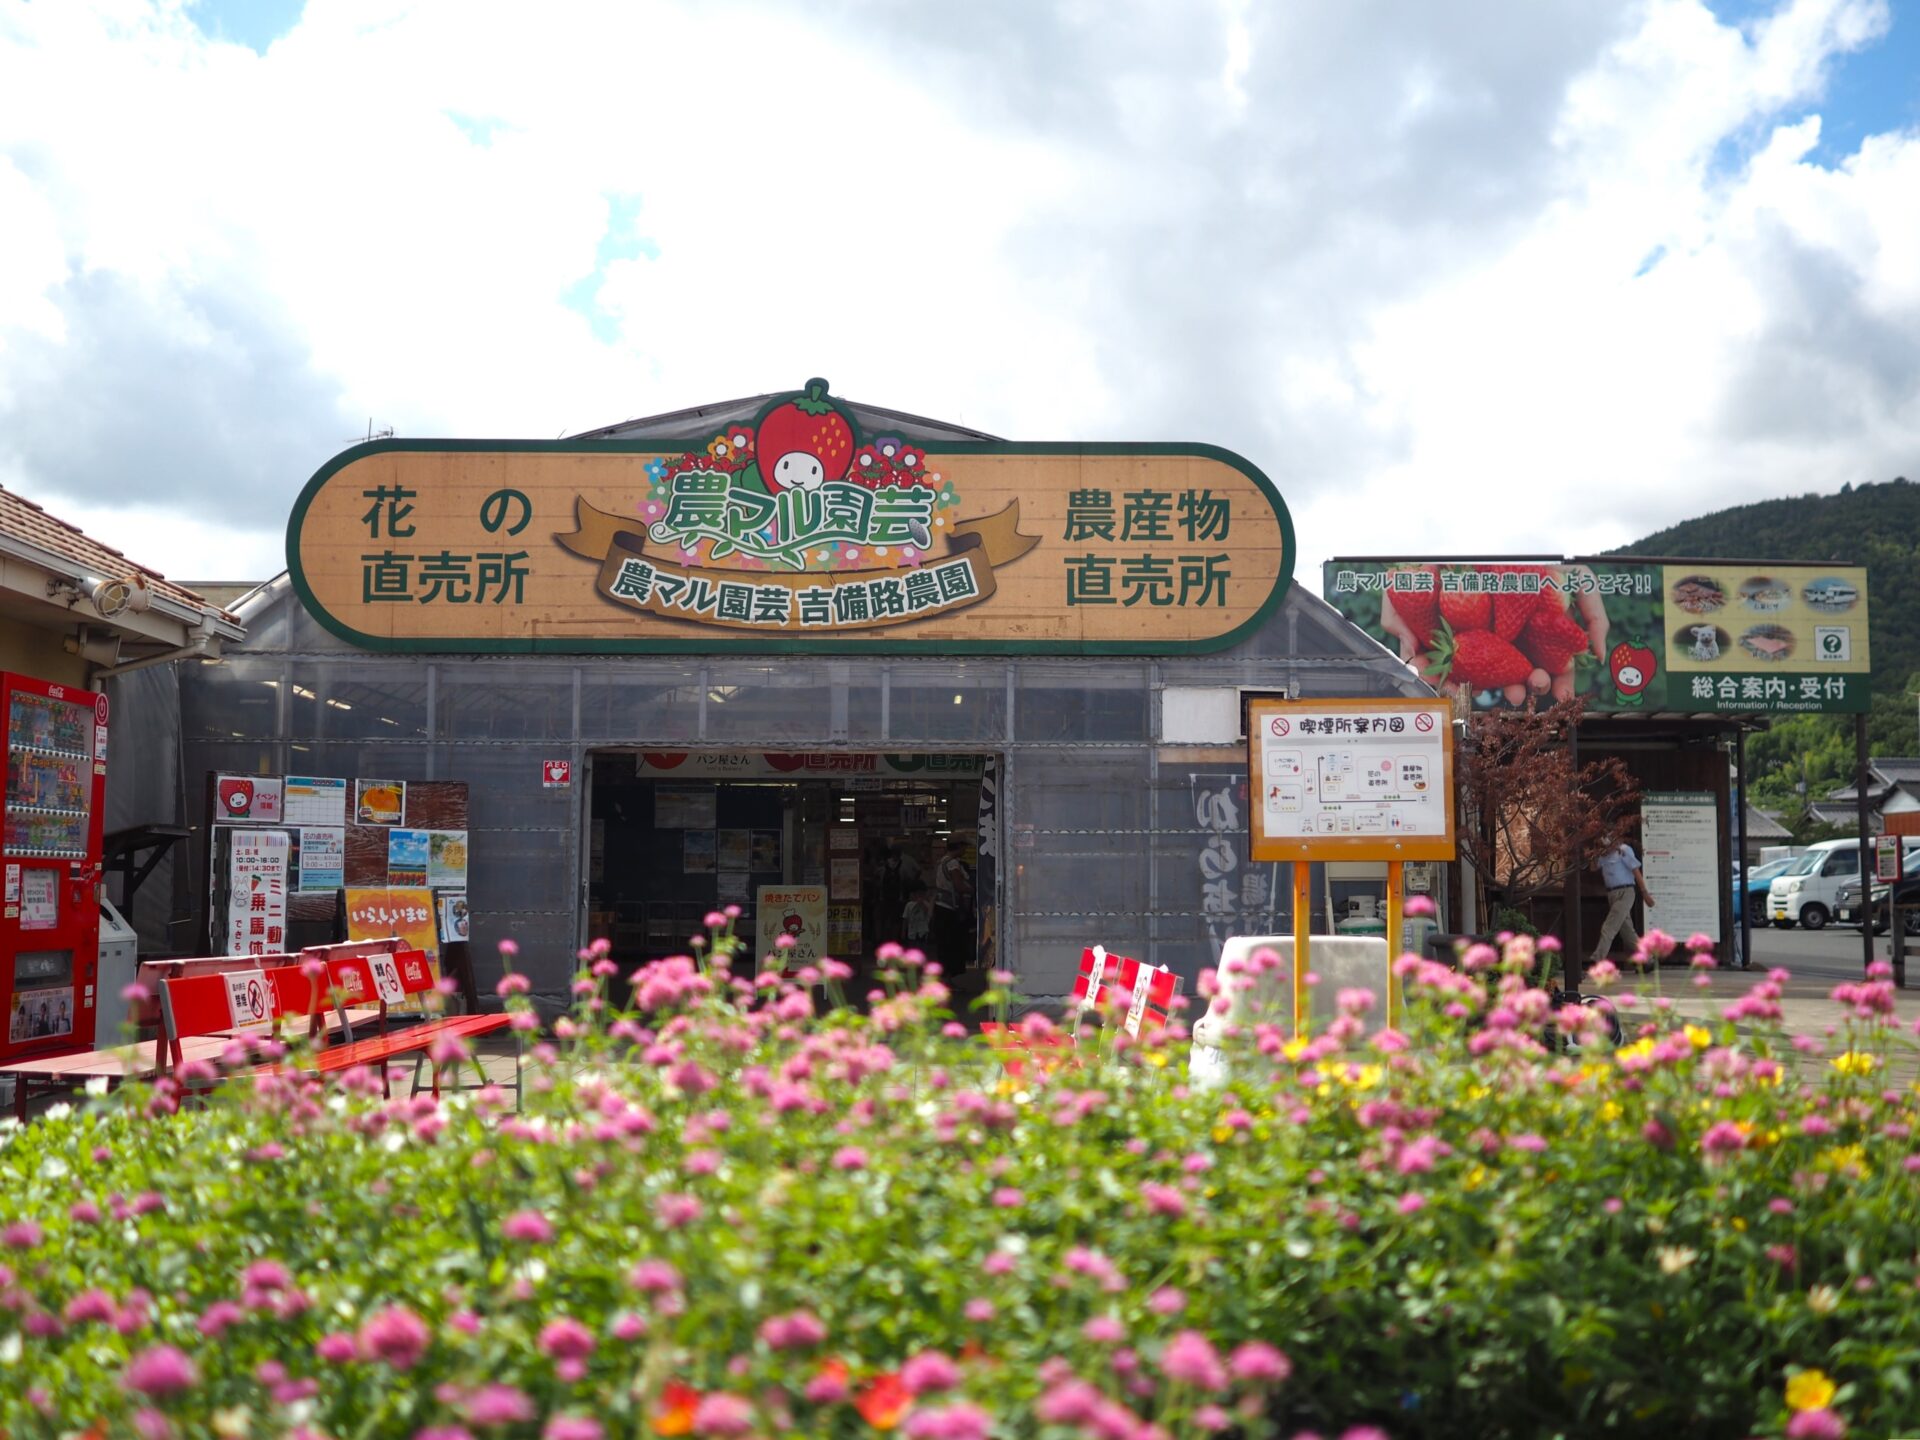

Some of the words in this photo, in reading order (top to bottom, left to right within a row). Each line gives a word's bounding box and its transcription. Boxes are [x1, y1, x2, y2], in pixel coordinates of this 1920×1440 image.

[662, 471, 936, 549] 農マル園芸
[1063, 488, 1230, 541] 農産物
[361, 551, 530, 604] 直売所
[1063, 553, 1231, 607] 直売所
[1336, 571, 1434, 592] 農マル園芸
[613, 558, 790, 625] 農マル園芸
[798, 557, 979, 625] 吉備路農園
[1691, 676, 1846, 700] 総合案内・受付
[1717, 701, 1768, 710] Information
[1777, 702, 1822, 711] Reception
[1300, 717, 1405, 734] 喫煙所案内図
[697, 754, 750, 766] パン屋さん
[764, 893, 821, 904] 焼きたてパン
[352, 906, 429, 925] いらっしゃいませ
